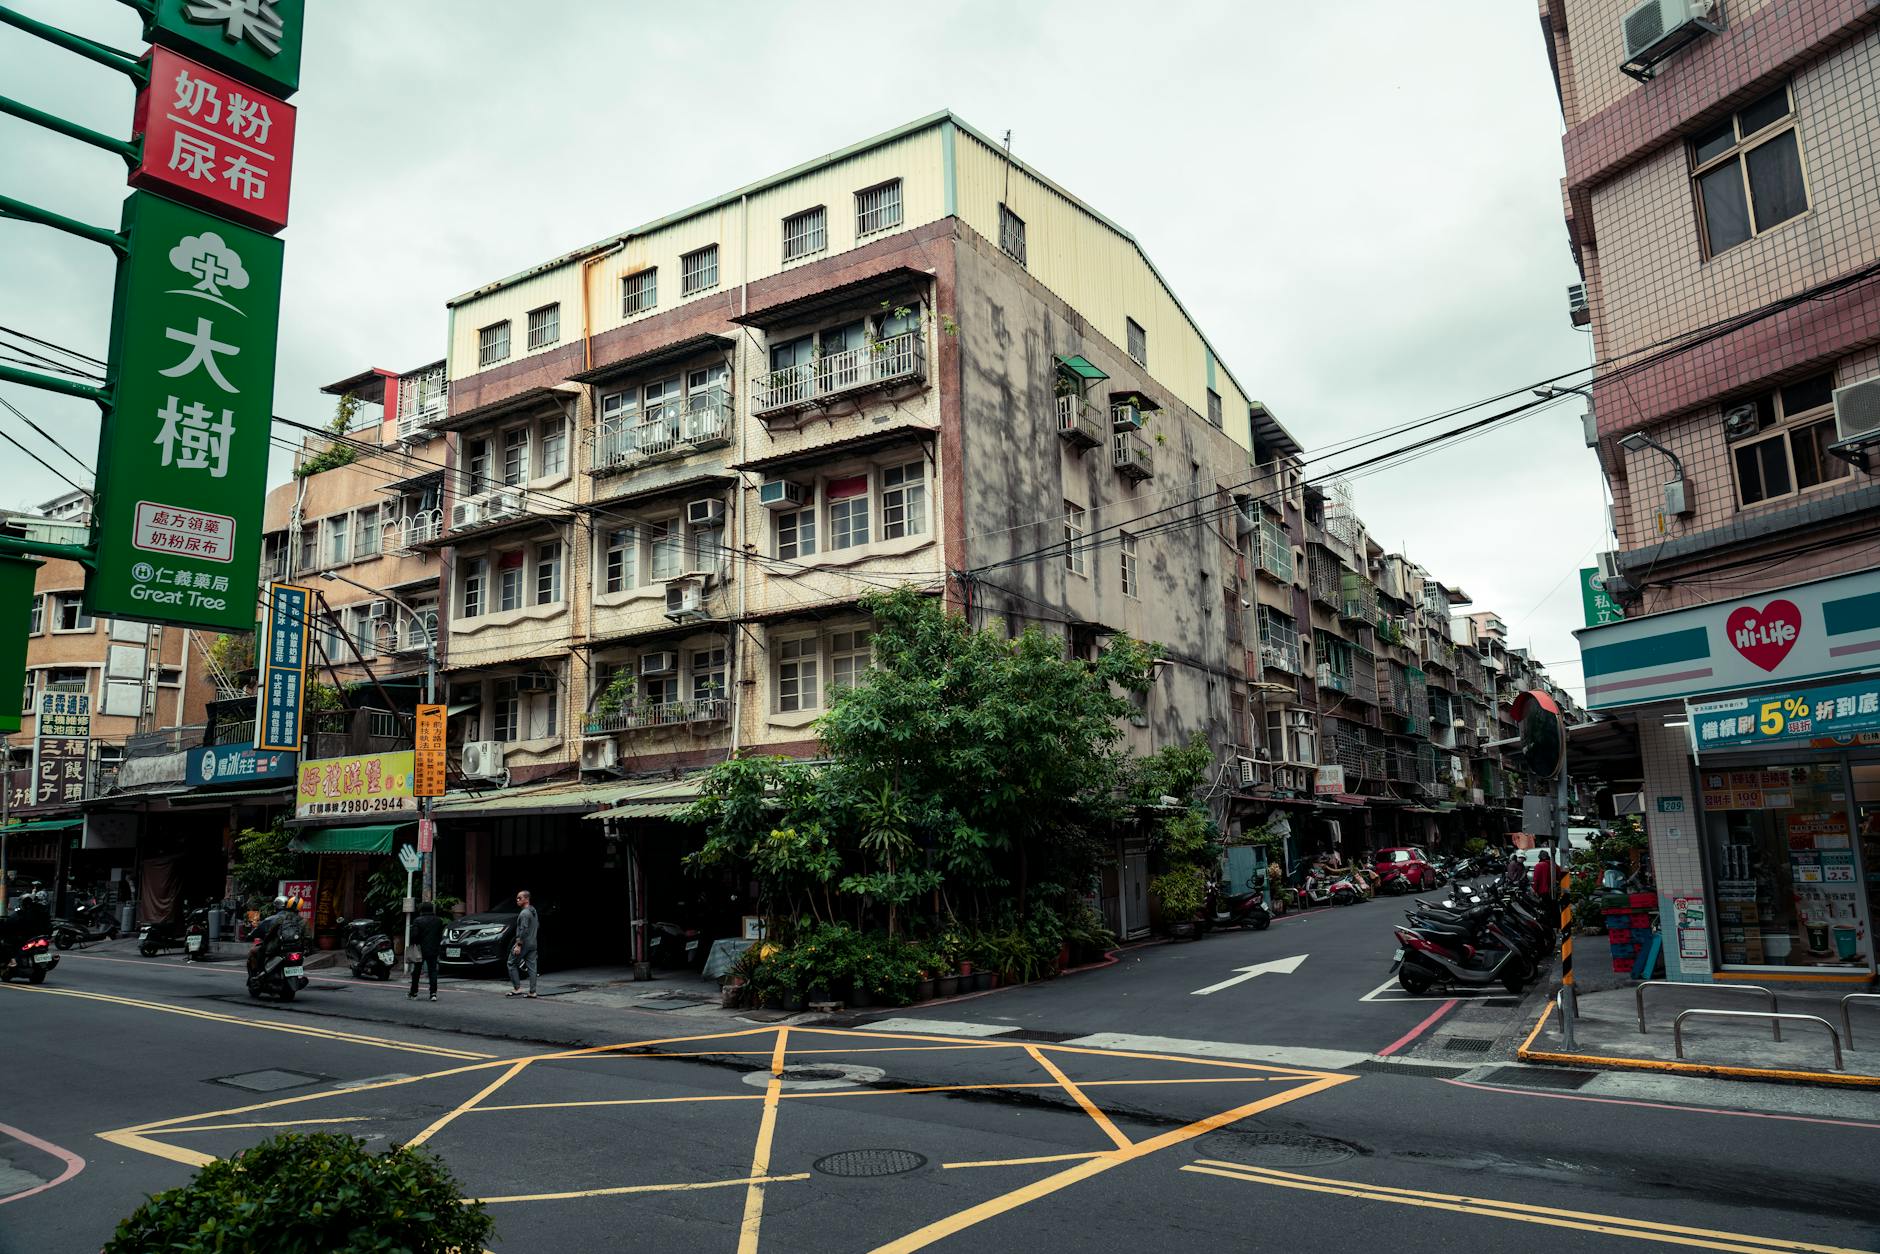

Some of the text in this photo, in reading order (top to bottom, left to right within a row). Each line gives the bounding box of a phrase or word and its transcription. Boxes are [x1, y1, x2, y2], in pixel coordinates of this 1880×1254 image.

[172, 70, 273, 145] 奶粉
[167, 132, 270, 201] 尿布
[152, 317, 242, 479] 大樹
[152, 510, 221, 534] 處方領藥
[150, 530, 219, 554] 奶粉尿布
[155, 566, 230, 592] 仁義藥局
[130, 583, 227, 611] Great Tree
[1594, 594, 1611, 624] 私立
[42, 714, 90, 727] 手機維修
[1701, 714, 1755, 741] 繼續刷
[1760, 696, 1809, 736] 5%
[1815, 692, 1879, 721] 折到底
[41, 725, 88, 737] 電池座充
[300, 758, 382, 798] 好禮漢堡
[340, 797, 403, 814] 2980-2944
